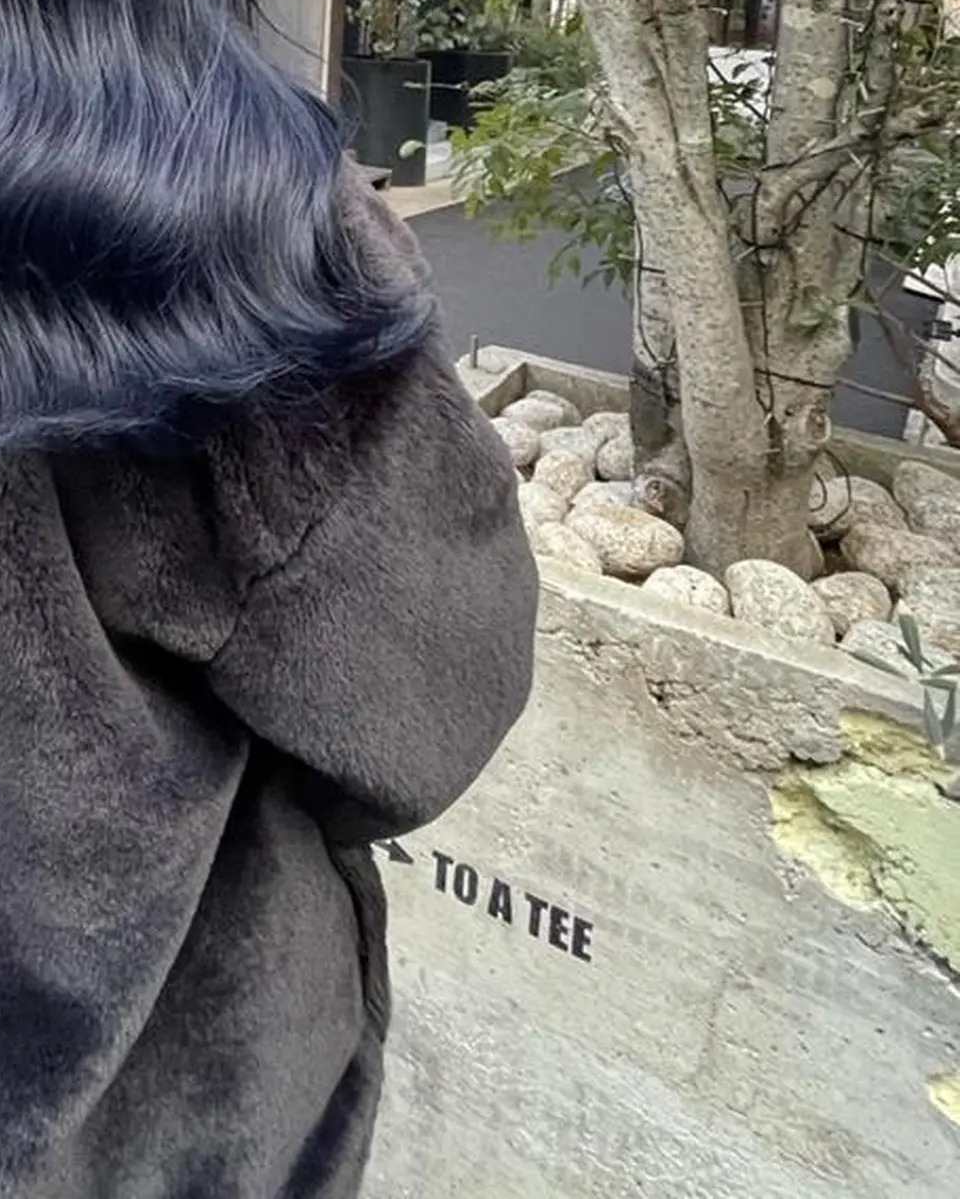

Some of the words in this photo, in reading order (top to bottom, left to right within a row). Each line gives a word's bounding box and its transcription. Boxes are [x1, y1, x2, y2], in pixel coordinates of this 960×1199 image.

[432, 850, 478, 906] TO
[487, 877, 512, 925] A
[524, 891, 594, 963] TEE
